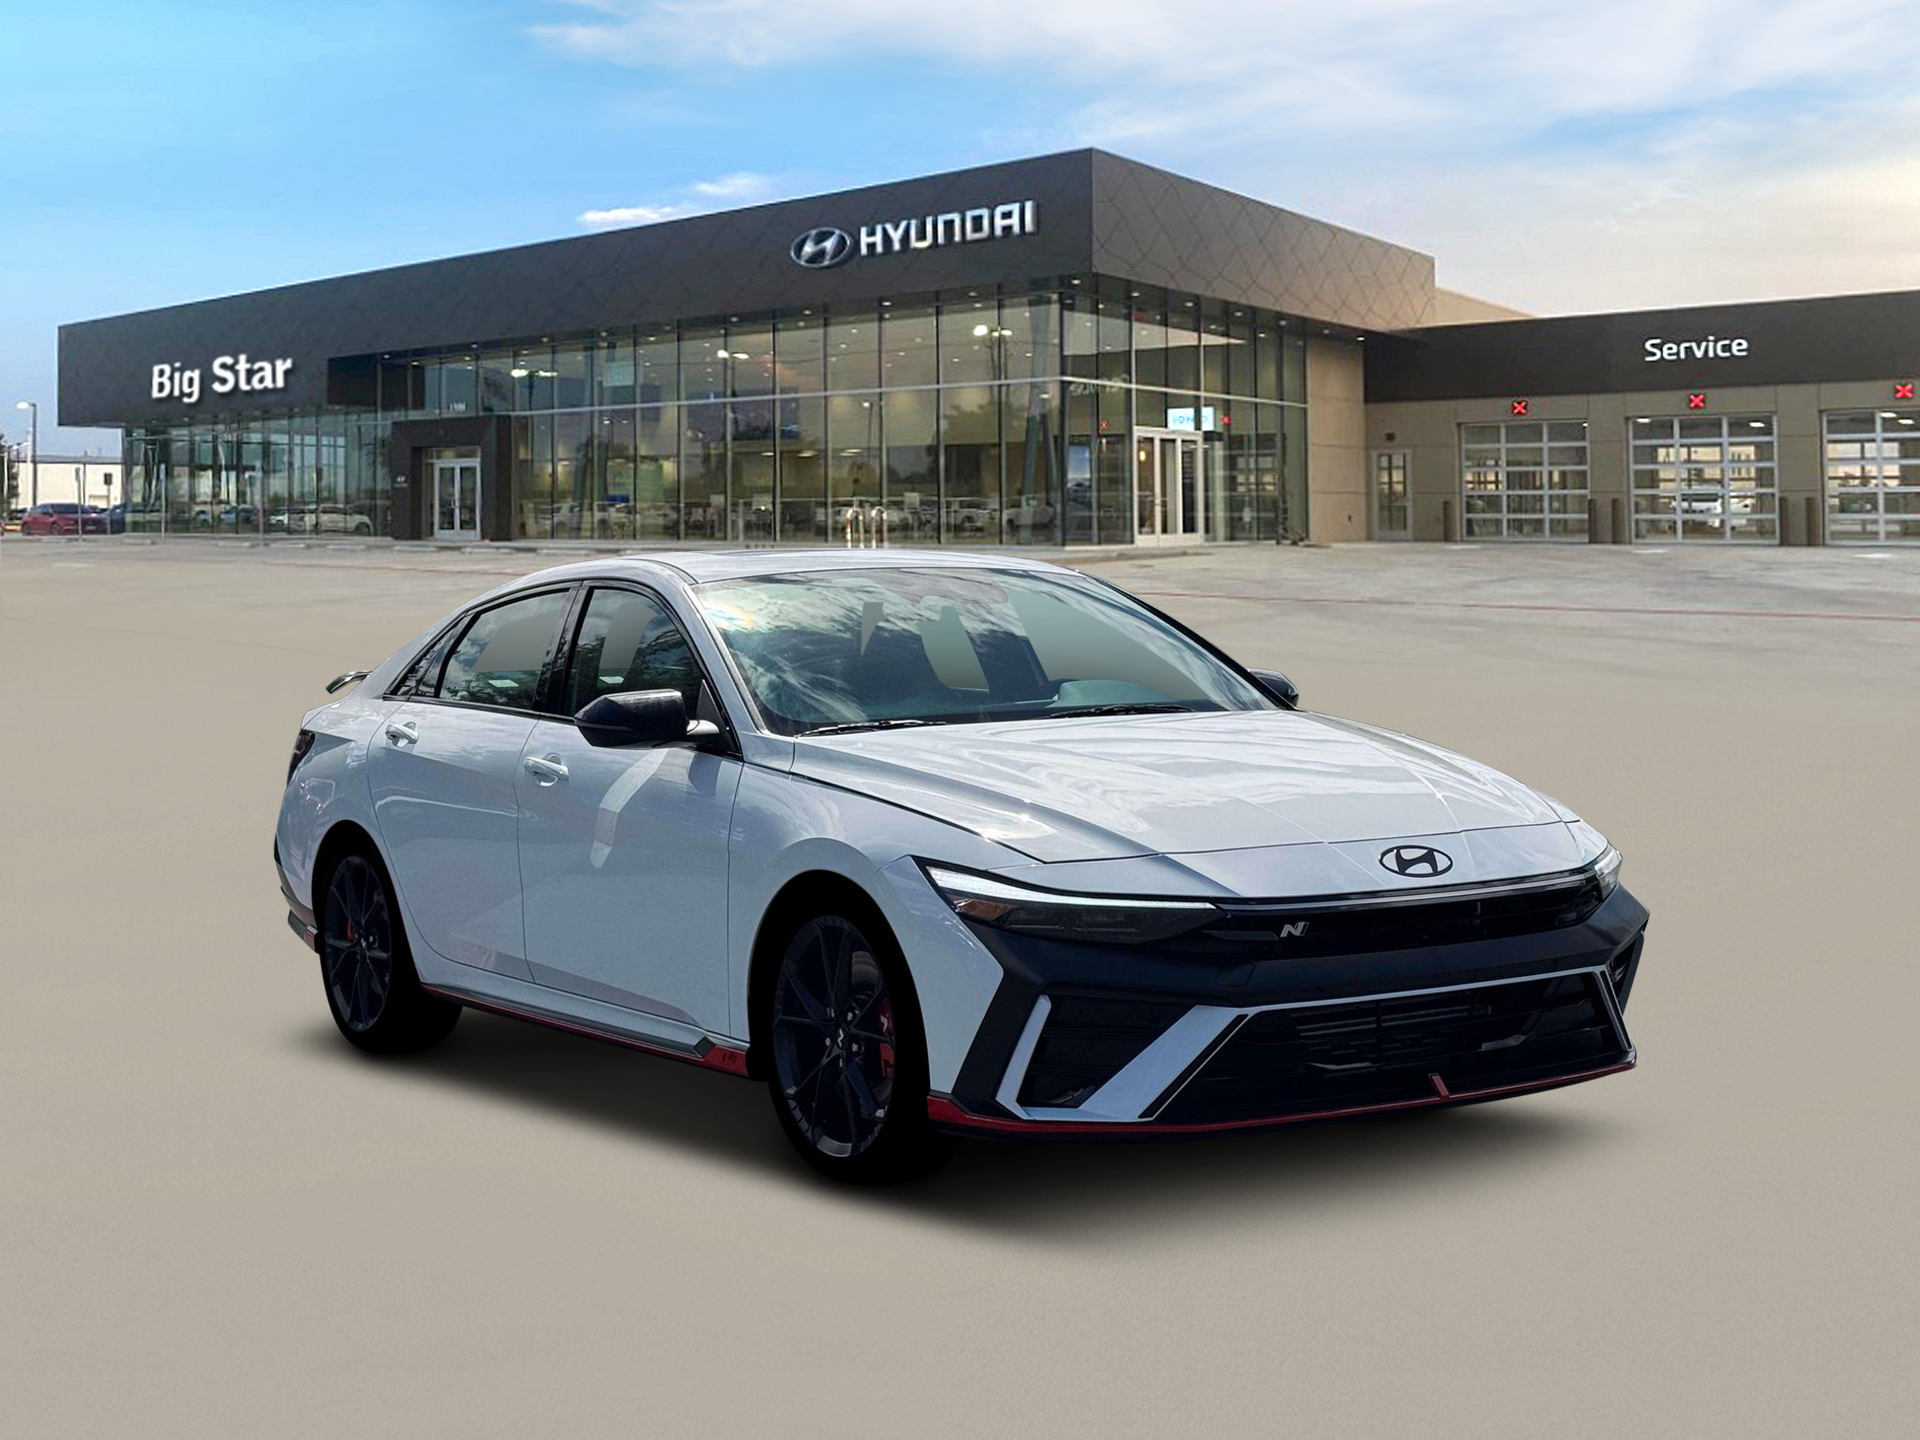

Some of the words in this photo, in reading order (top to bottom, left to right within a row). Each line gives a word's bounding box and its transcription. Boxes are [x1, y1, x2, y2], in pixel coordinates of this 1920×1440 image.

[860, 200, 1037, 256] HYUNDAI
[1644, 335, 1748, 361] Service
[151, 361, 200, 403] Big
[211, 353, 293, 393] Star
